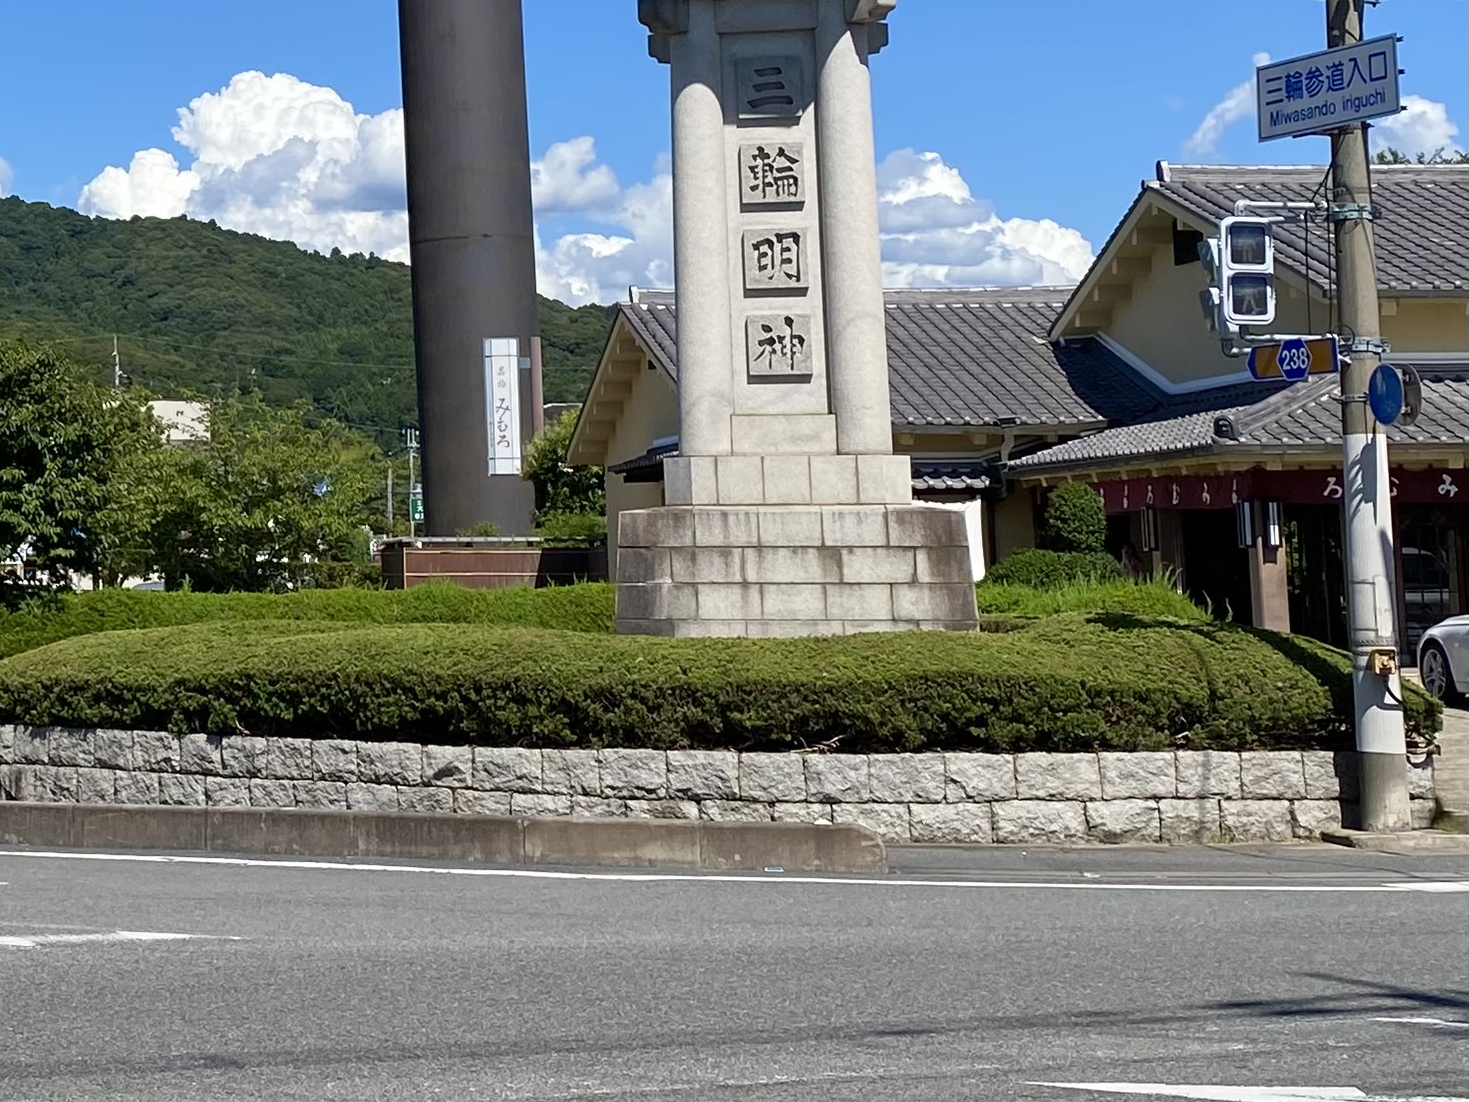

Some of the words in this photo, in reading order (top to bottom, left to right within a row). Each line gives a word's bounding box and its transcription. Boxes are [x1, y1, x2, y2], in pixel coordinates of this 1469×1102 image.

[1265, 51, 1388, 106] 三輪参道入口
[1270, 101, 1336, 127] Miwasando
[1342, 87, 1386, 113] iriguchi
[747, 66, 805, 371] 三輪明神
[1281, 349, 1309, 371] 238
[496, 398, 511, 447] みむろ
